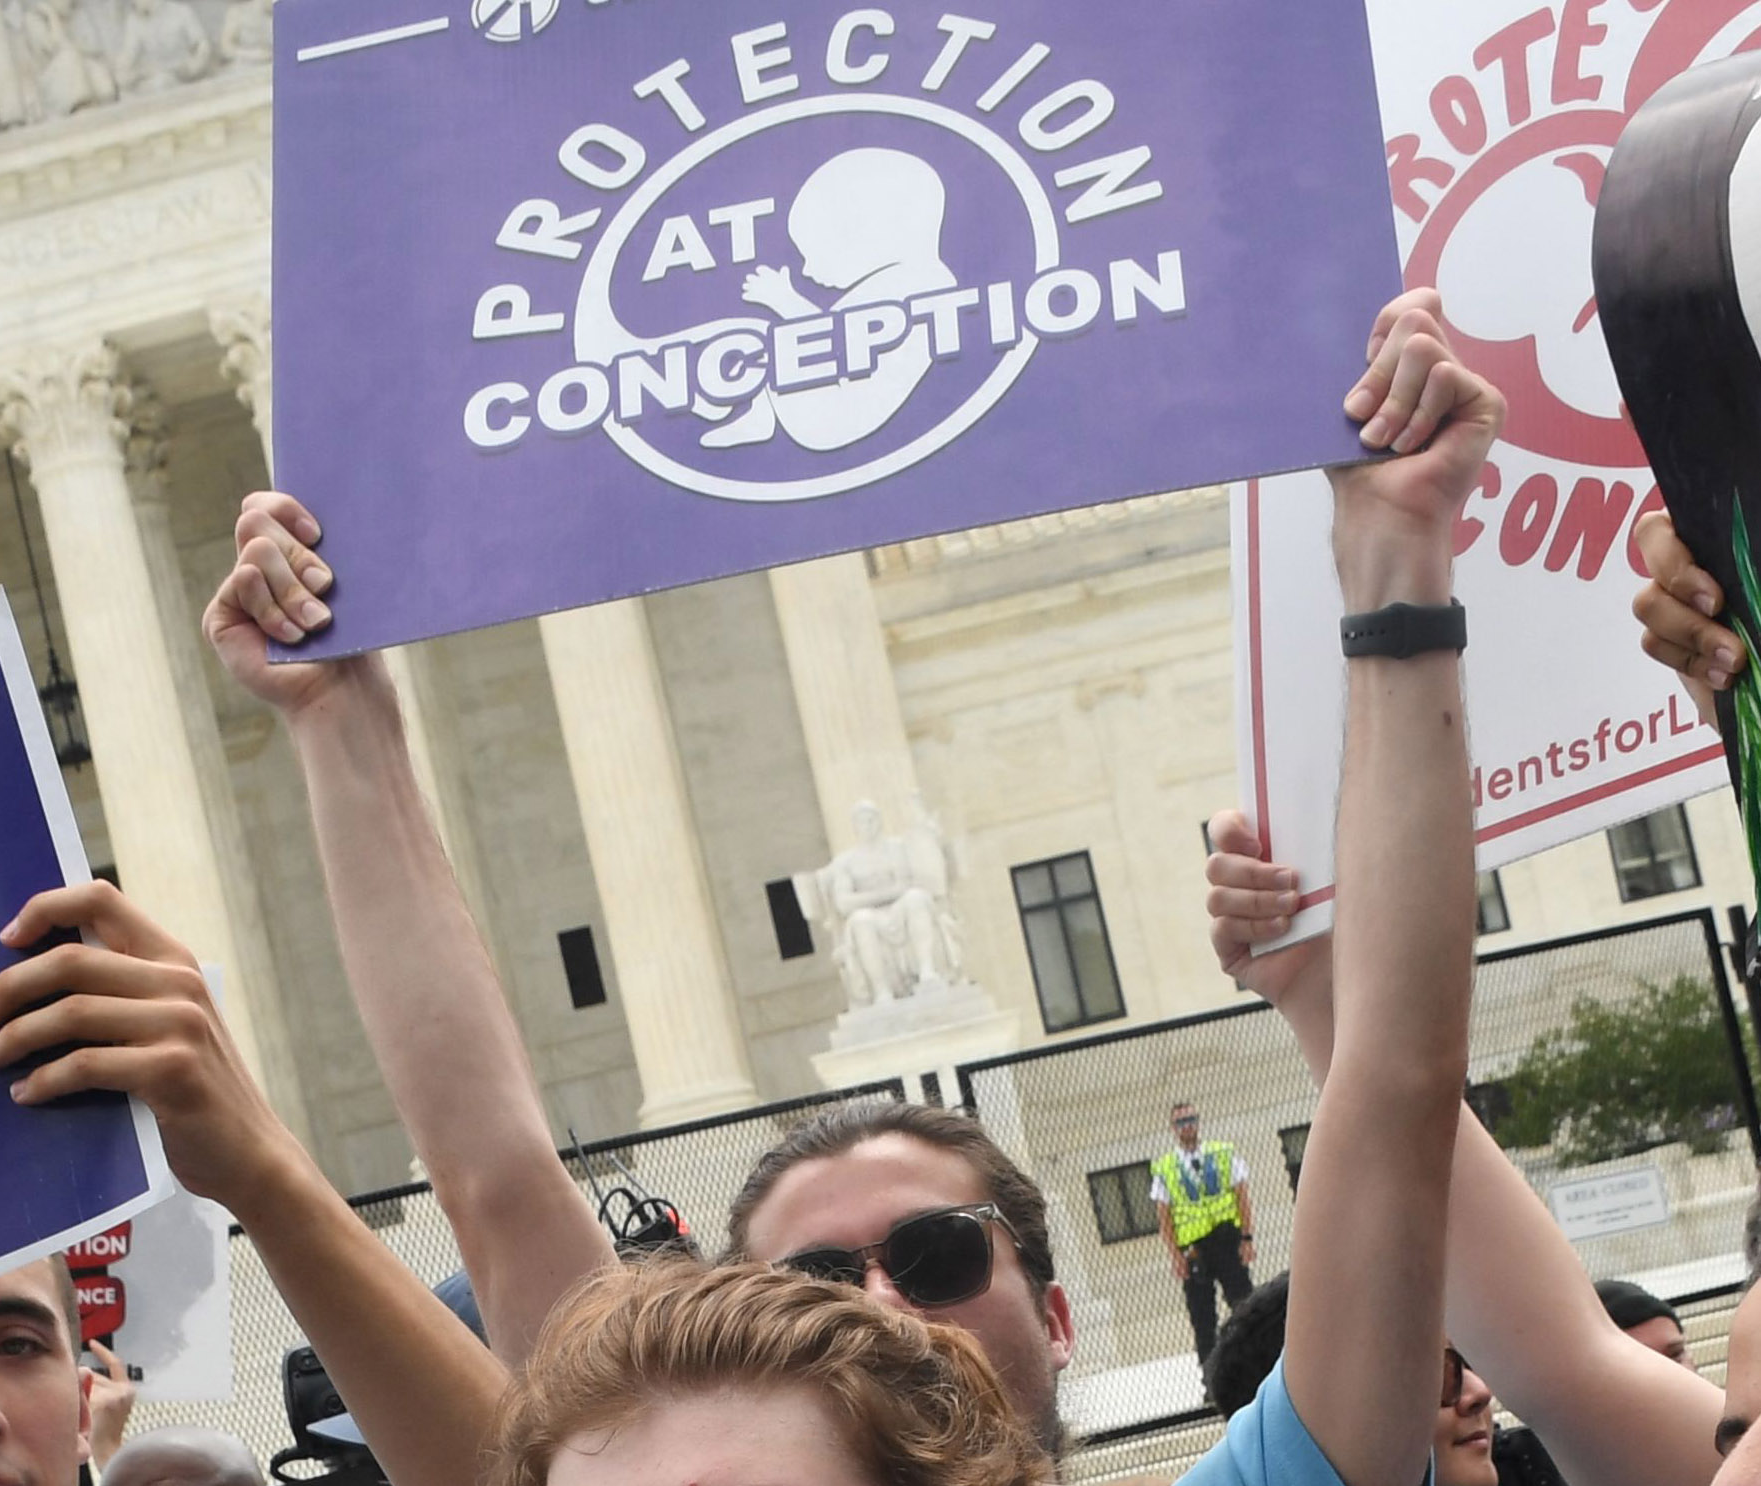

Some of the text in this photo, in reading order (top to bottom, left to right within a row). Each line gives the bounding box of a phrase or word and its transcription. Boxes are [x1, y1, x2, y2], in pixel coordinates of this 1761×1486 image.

[472, 8, 1164, 340] PROTECTION
[1386, 0, 1619, 223] ROTE
[642, 197, 775, 282] AT
[463, 249, 1188, 448] CONCEPTION
[1471, 693, 1707, 808] entsforL
